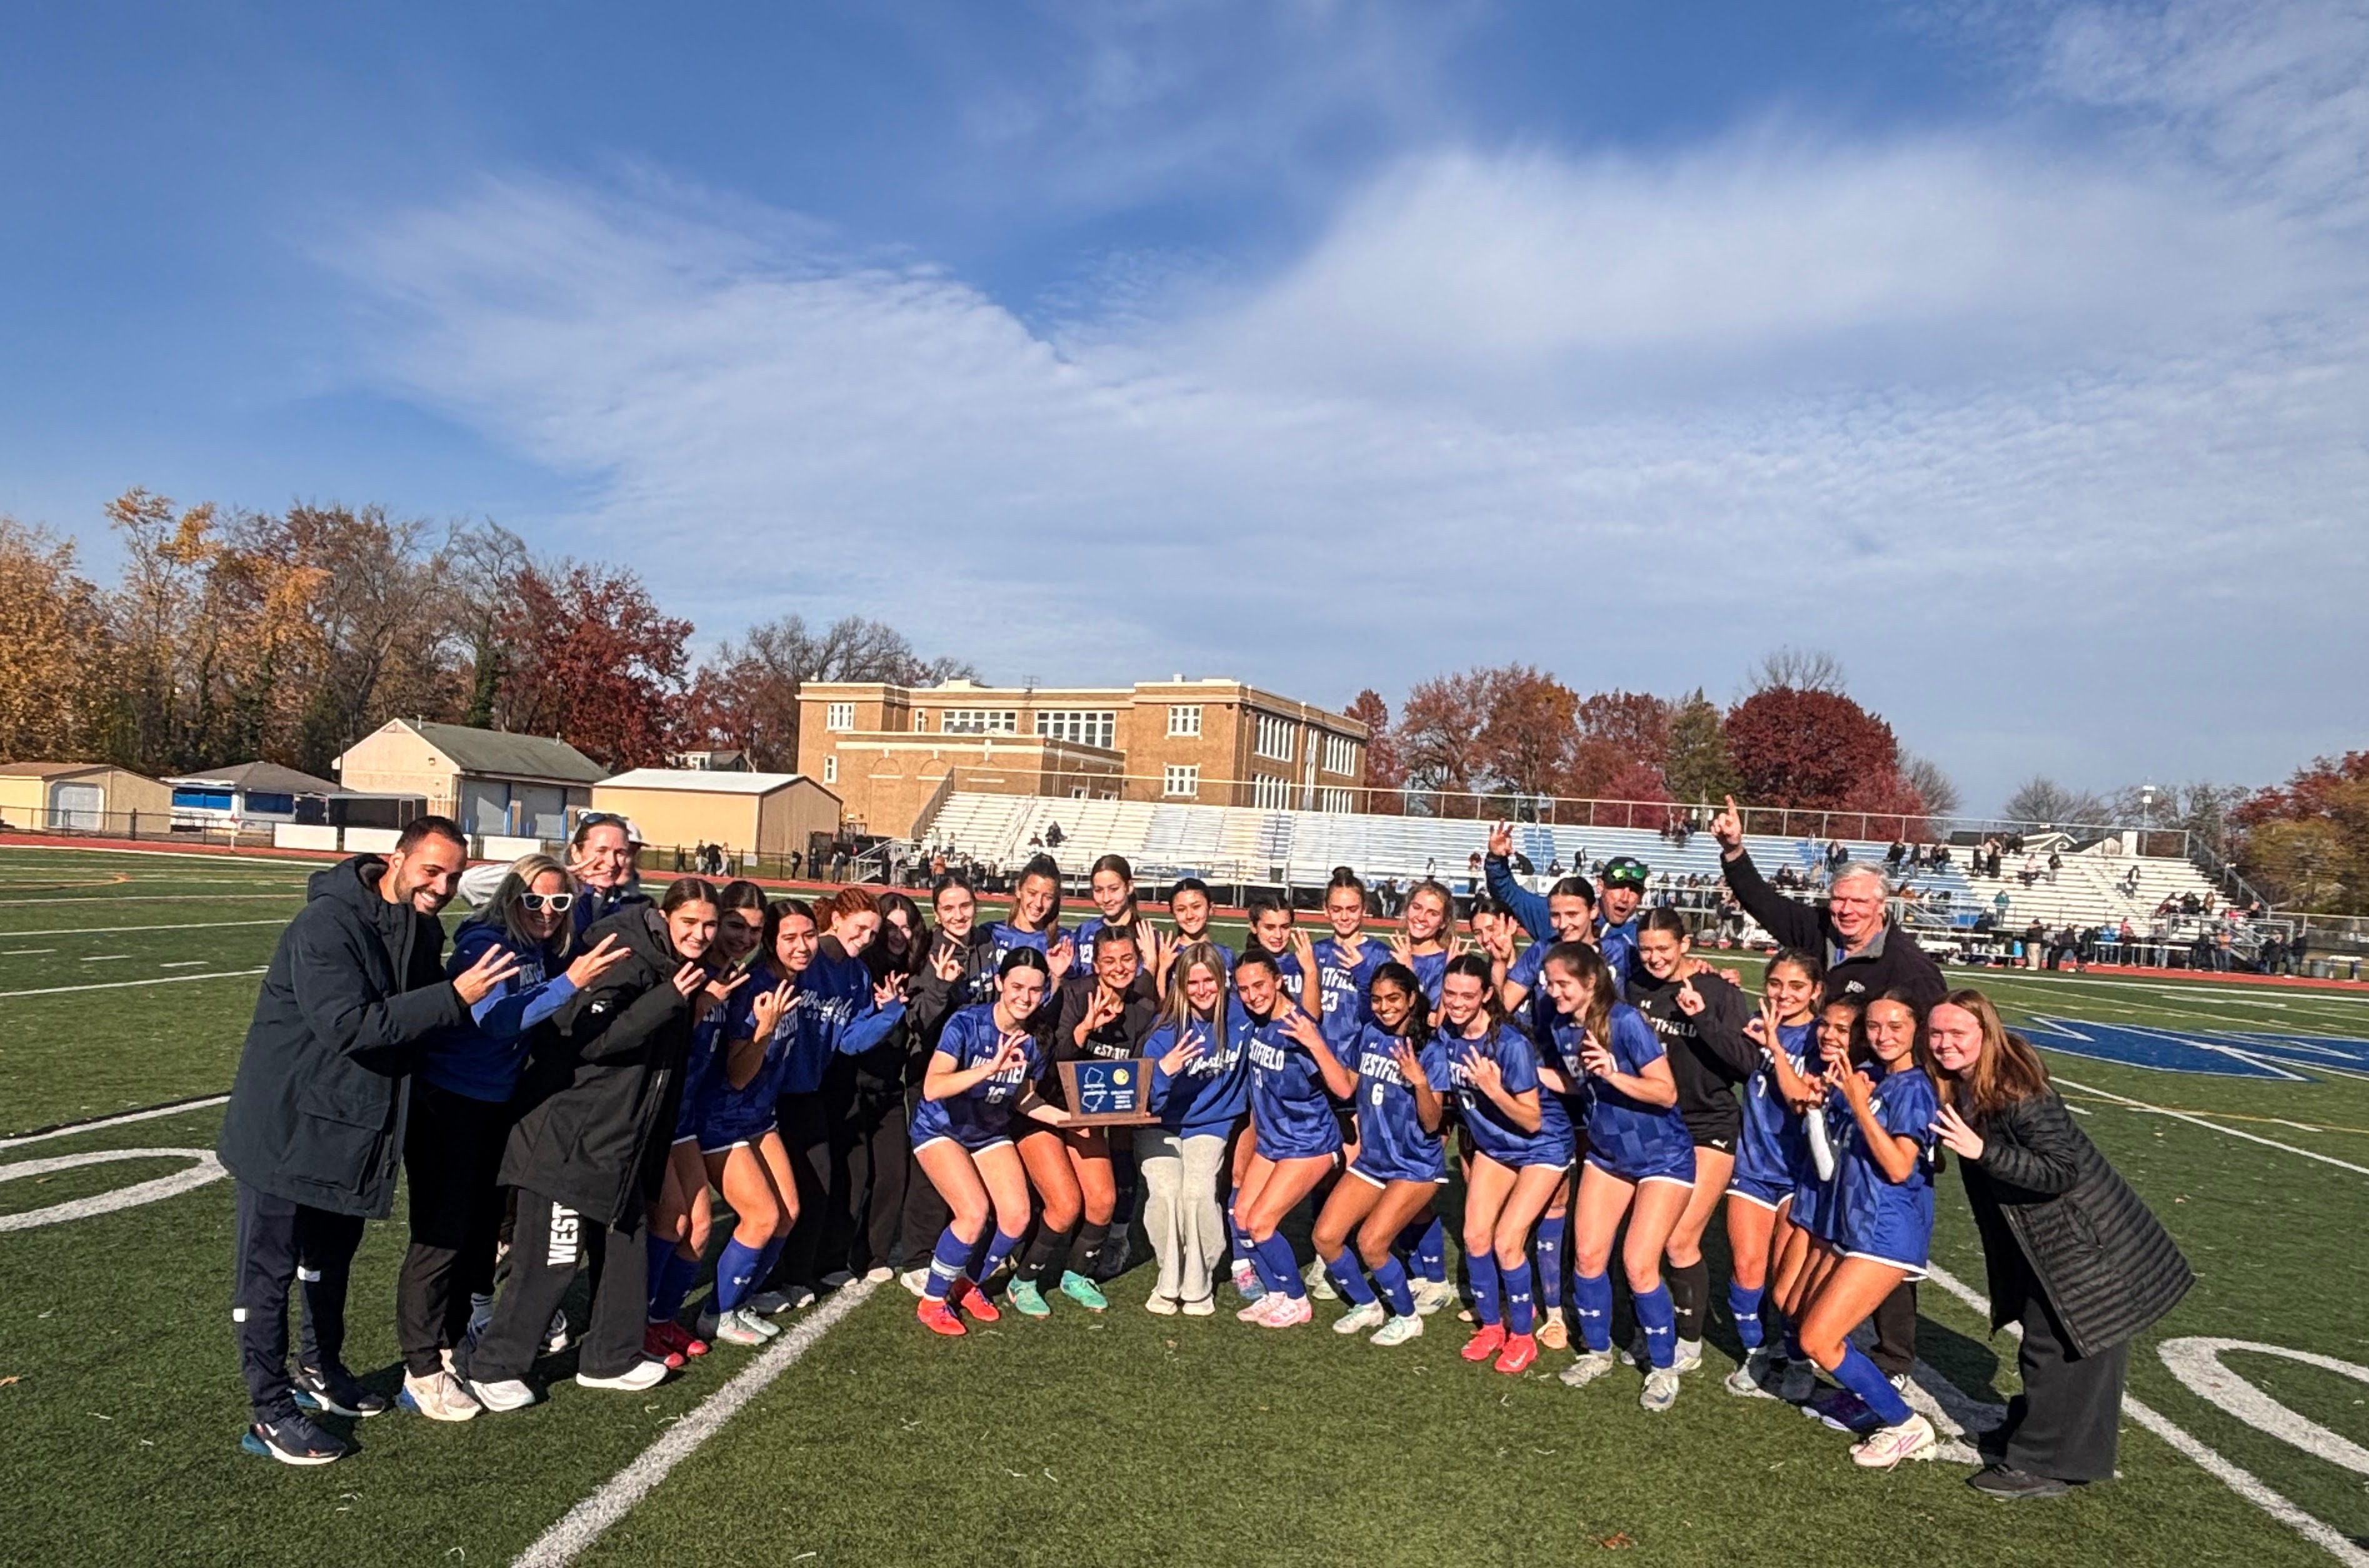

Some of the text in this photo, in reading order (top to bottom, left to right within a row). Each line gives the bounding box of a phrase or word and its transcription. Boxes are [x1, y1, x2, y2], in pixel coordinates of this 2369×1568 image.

[1321, 990, 1339, 1012] 23
[984, 1086, 1007, 1104] 16
[1371, 1082, 1385, 1106] 6
[1757, 1075, 1767, 1097] 7
[547, 1201, 579, 1268] WEST
